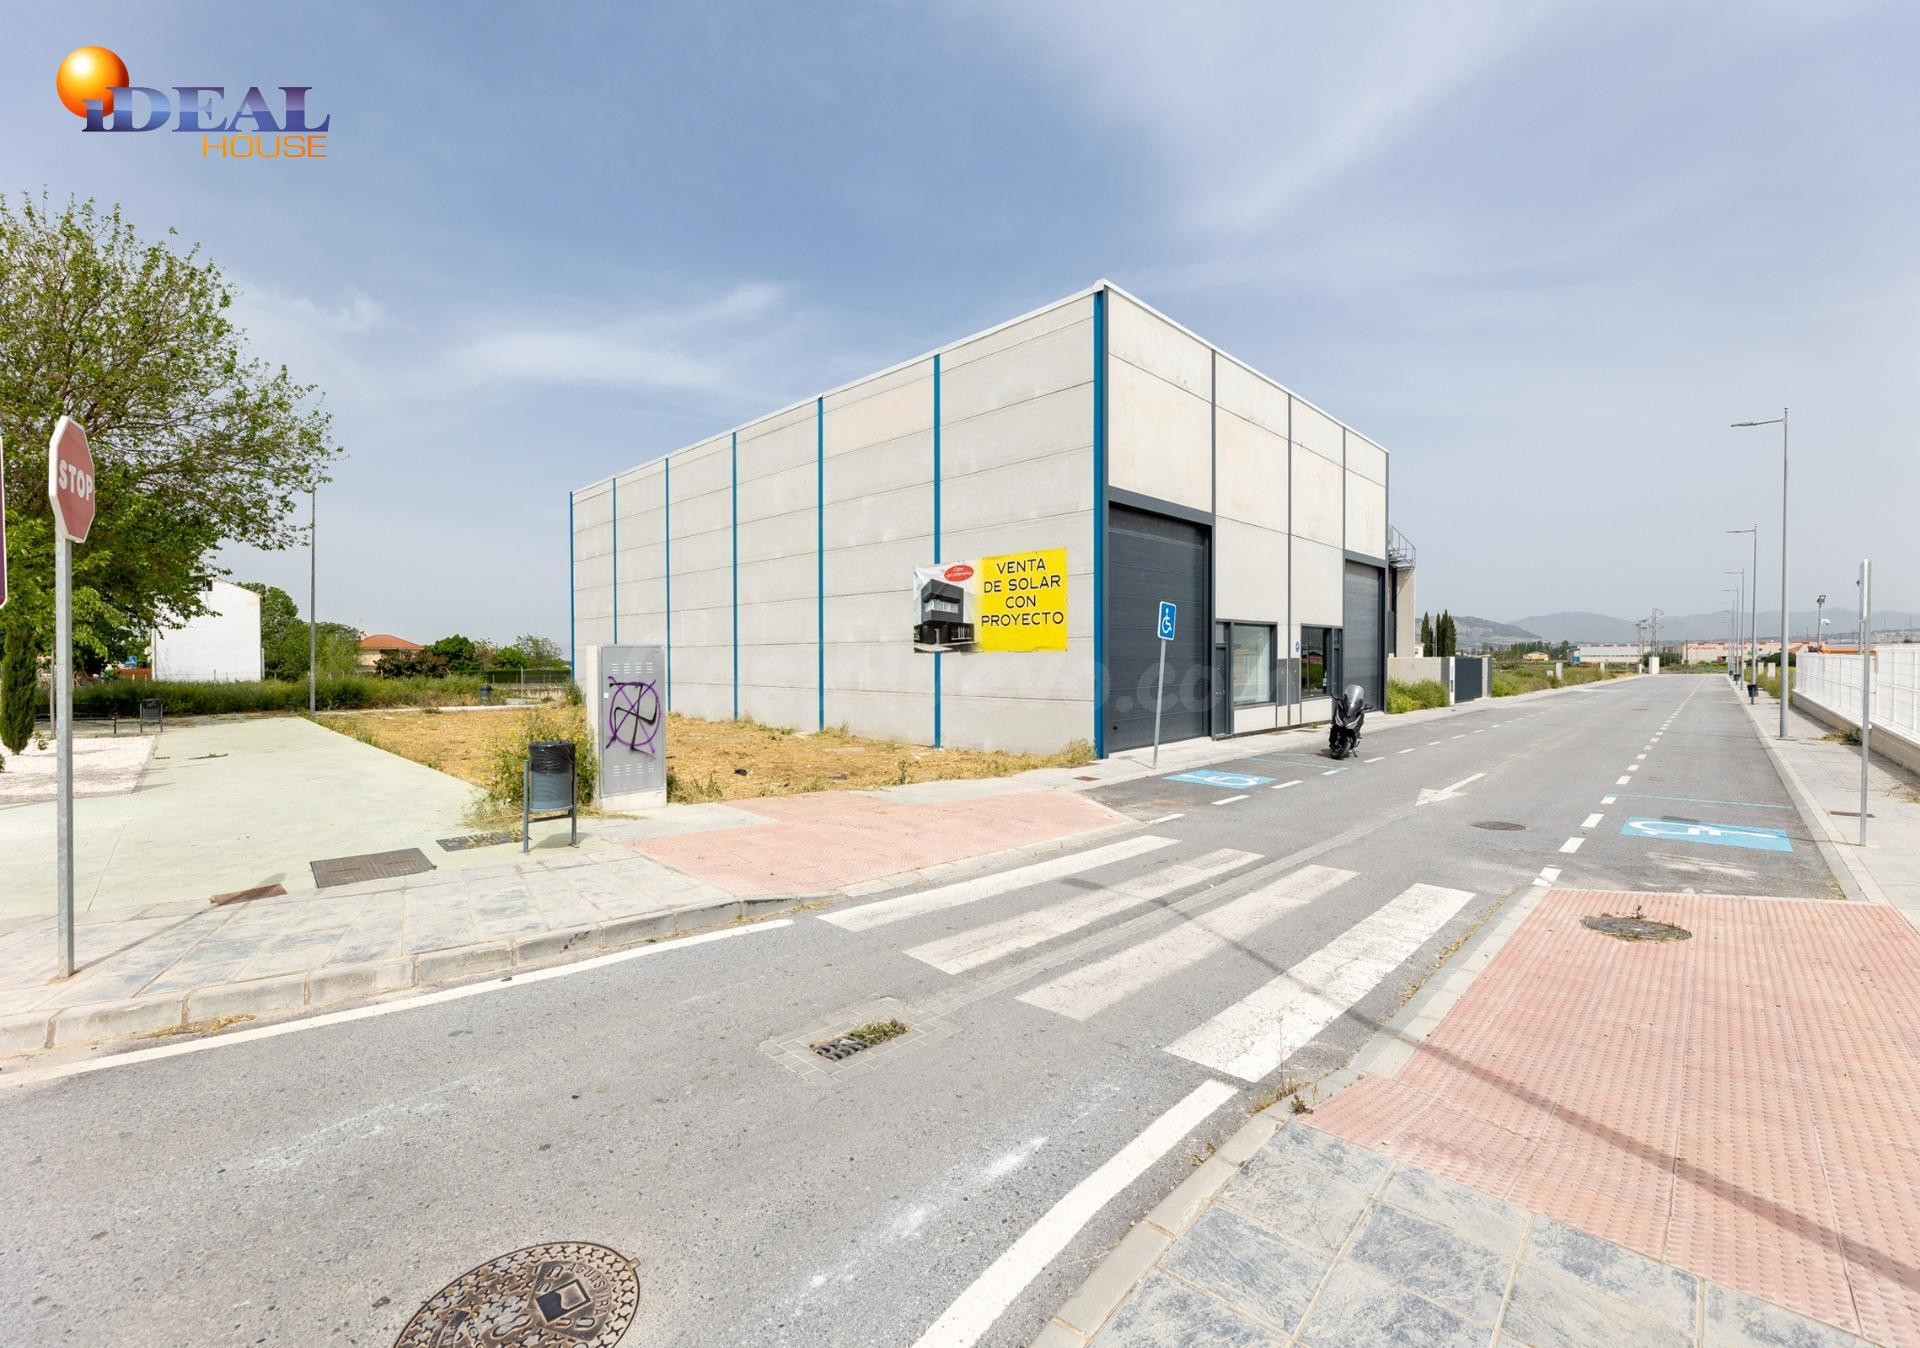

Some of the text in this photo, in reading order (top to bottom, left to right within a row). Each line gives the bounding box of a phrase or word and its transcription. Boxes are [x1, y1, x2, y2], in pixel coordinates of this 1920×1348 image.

[58, 458, 93, 501] STOP
[996, 558, 1046, 574] VENTA
[984, 575, 1061, 593] DE SOLAR
[1005, 595, 1036, 609] CON
[981, 611, 1064, 627] PROYECTO
